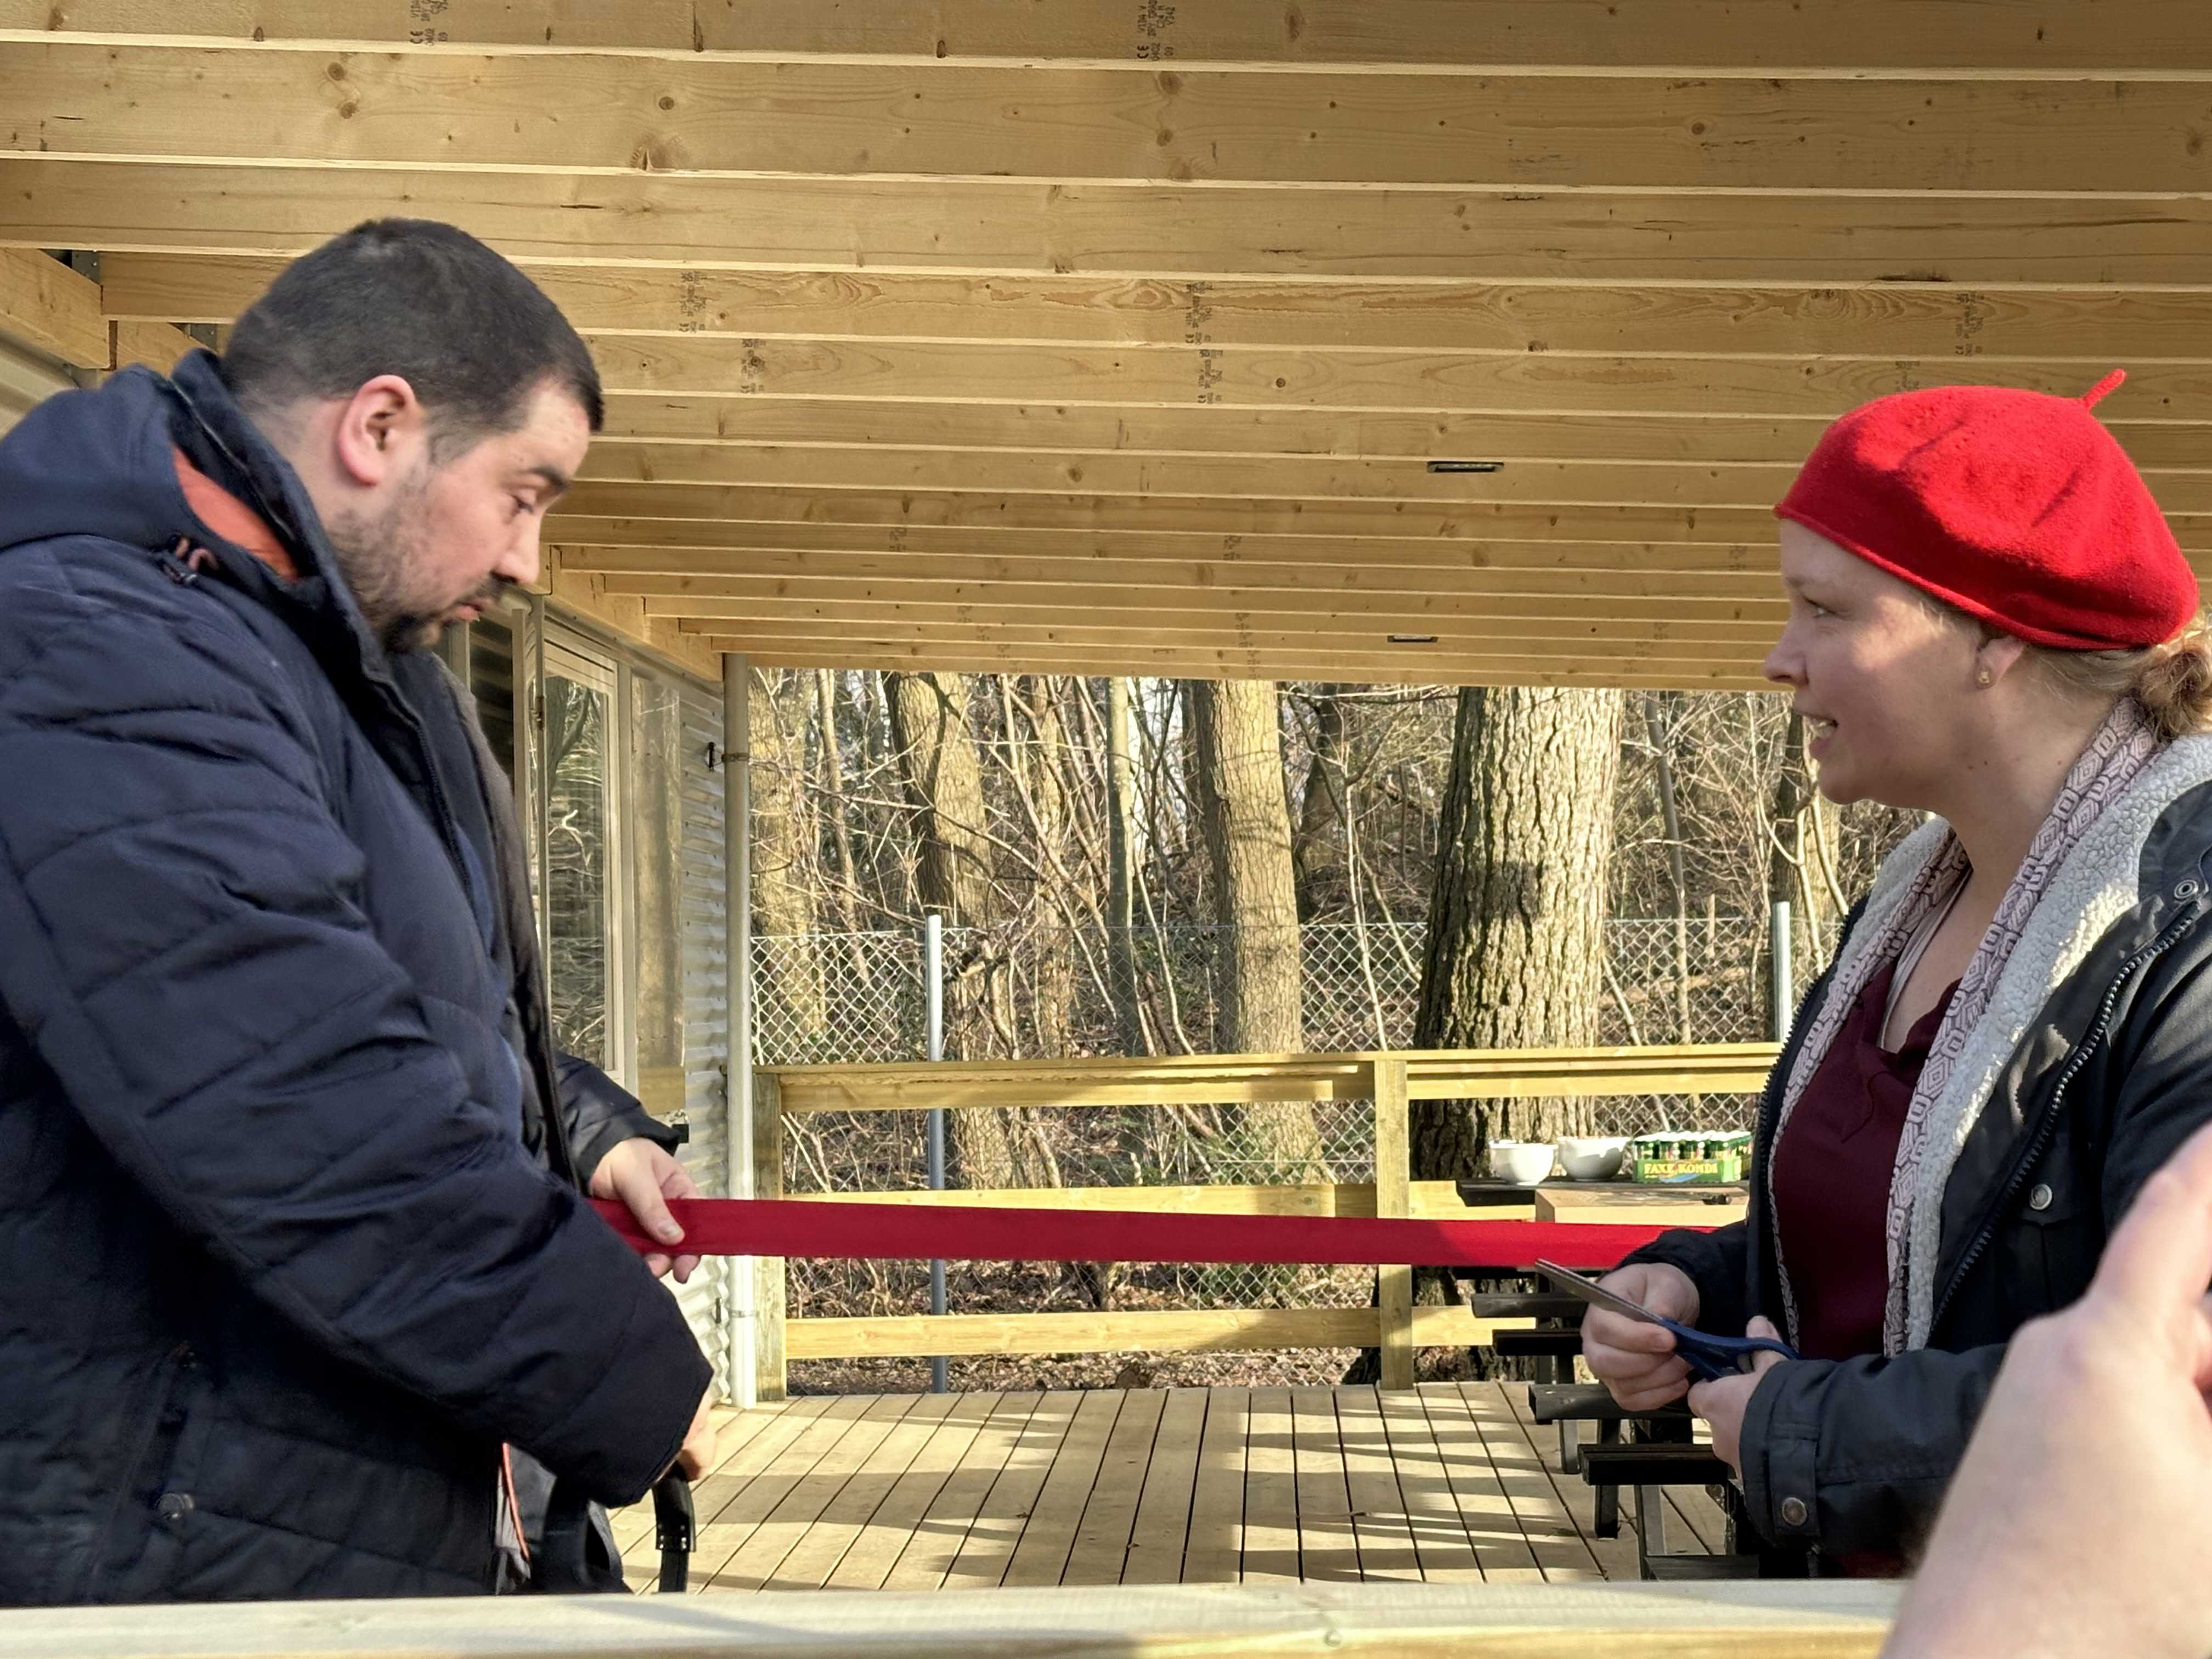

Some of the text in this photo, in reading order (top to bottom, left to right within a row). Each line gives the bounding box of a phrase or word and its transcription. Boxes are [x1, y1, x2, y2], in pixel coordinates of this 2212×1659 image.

[1137, 45, 1149, 59] CE
[1644, 1163, 1718, 1174] FAXE KONDI
